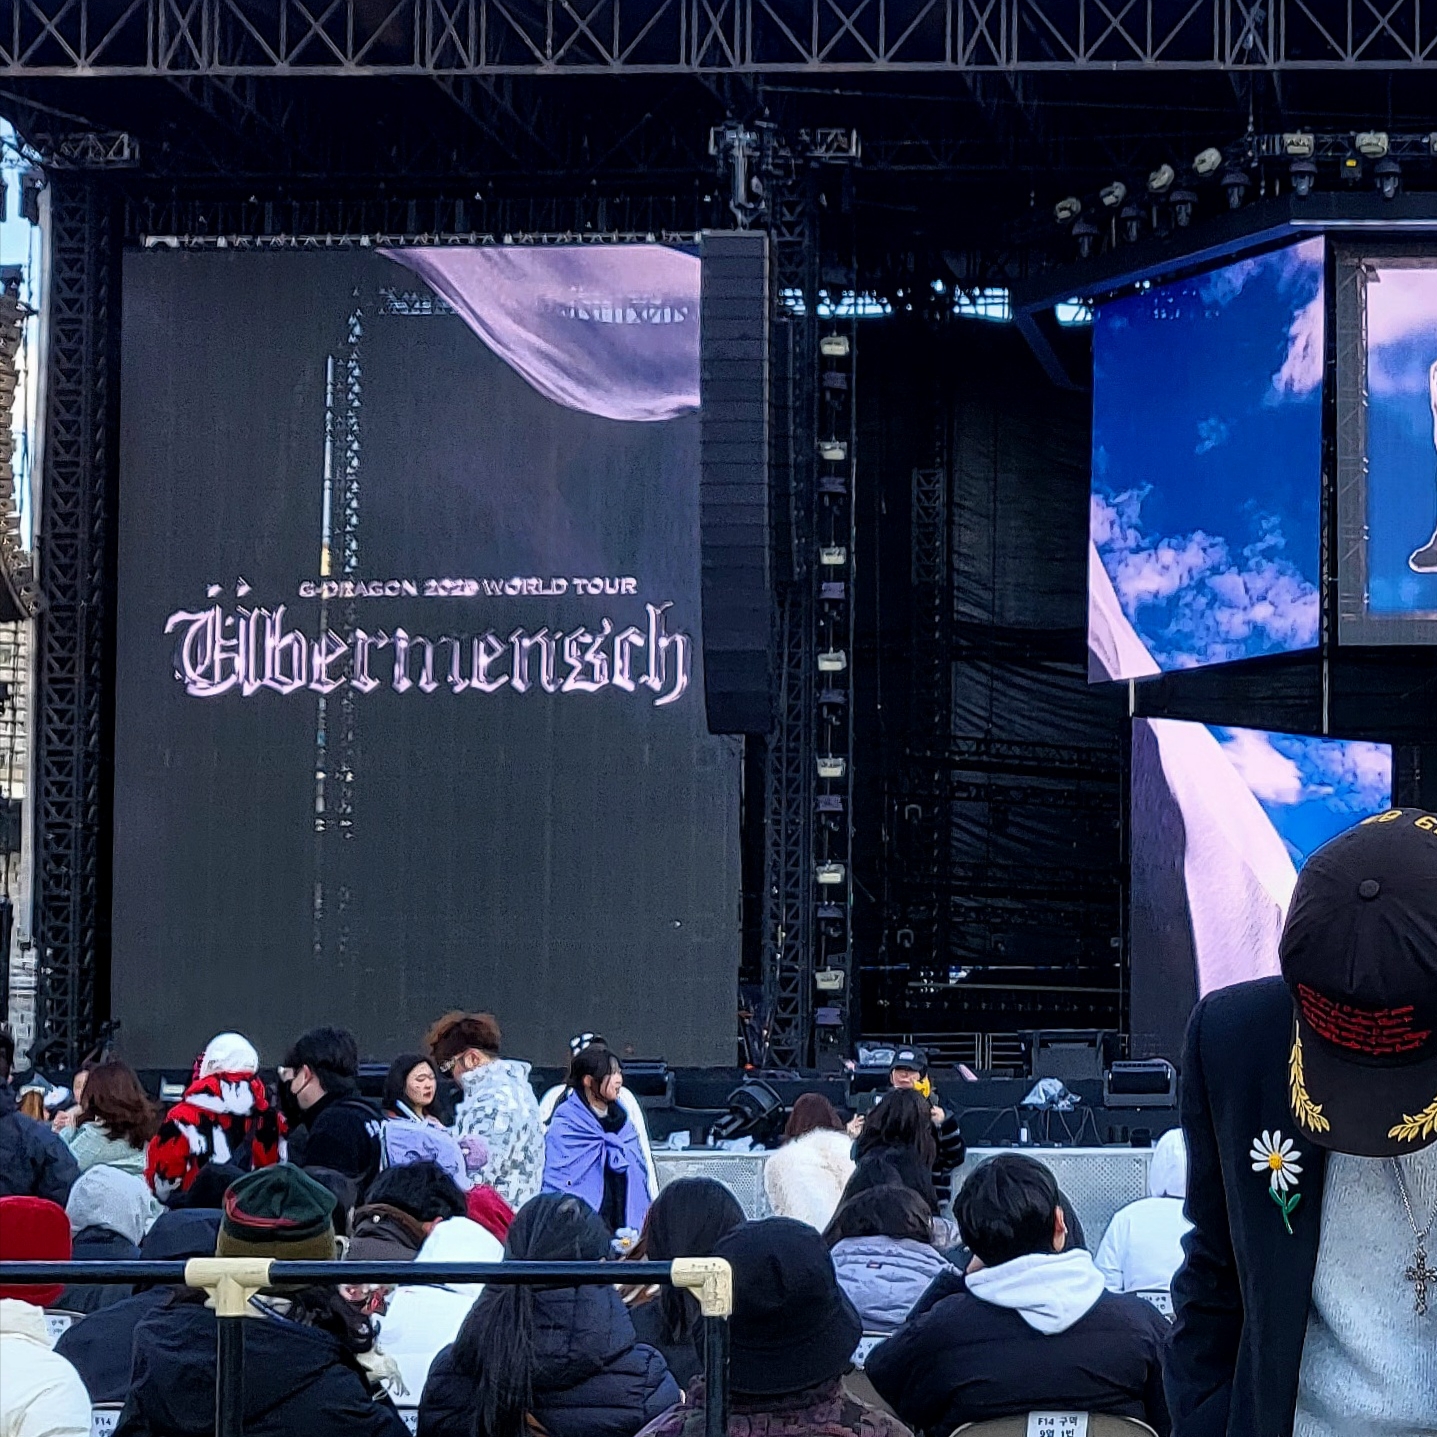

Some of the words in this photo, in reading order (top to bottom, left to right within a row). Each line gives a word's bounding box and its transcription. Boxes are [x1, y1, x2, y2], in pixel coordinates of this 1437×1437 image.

[299, 579, 419, 598] G-DRAGON
[481, 577, 568, 596] WORLD
[572, 576, 638, 595] TOUR
[1038, 1417, 1055, 1426] F14
[1059, 1416, 1078, 1427] 구역
